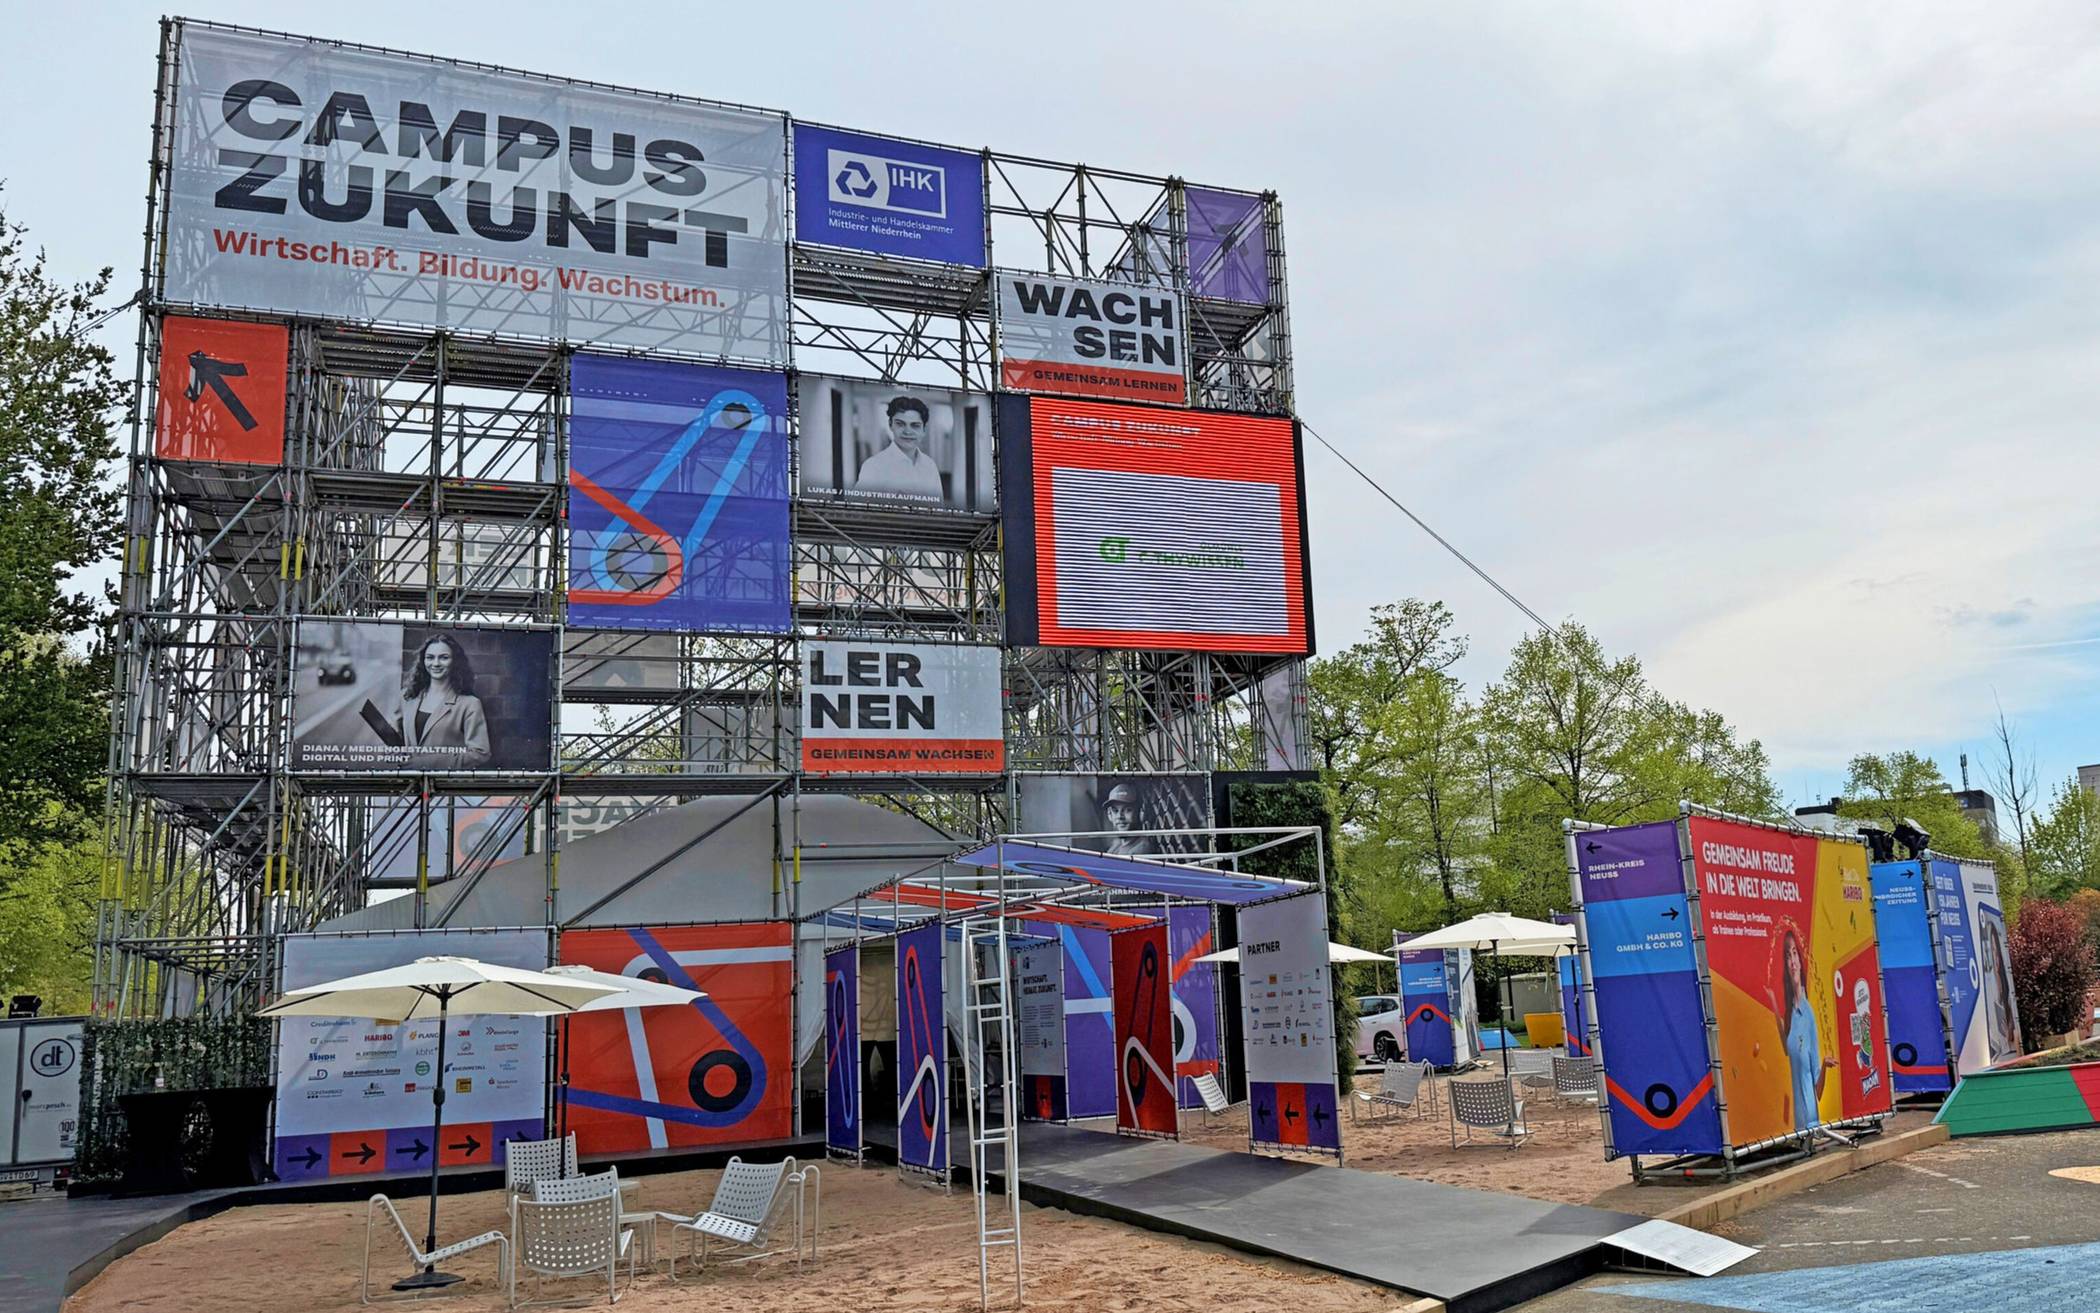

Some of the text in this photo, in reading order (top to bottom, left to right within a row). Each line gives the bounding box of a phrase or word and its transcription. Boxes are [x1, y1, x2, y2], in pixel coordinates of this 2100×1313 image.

[222, 79, 707, 197] CAMPUS
[891, 167, 934, 193] IHK
[214, 148, 749, 269] ZUKUNFT
[828, 207, 954, 234] Industrie- und Handelskammer
[828, 218, 922, 240] Mittlerer Niederrhein
[213, 228, 726, 308] Wirtschaft. Bildung. Wachstum.
[1013, 280, 1174, 330] WACH
[1073, 325, 1176, 366] SEN
[1033, 369, 1178, 393] GEMEINSAM LERNEN
[807, 486, 838, 495] LUKAS
[843, 489, 941, 503] INDUSTRIEKAUFMANN
[810, 650, 924, 688] LER
[810, 693, 936, 730] NEN
[302, 744, 339, 752] DIANA
[349, 745, 467, 754] MEDIENGESTALTERIN
[302, 754, 411, 763] DIGITAL UND PRINT
[810, 748, 995, 761] GEMEINSAM WACHSEN
[1588, 859, 1646, 872] RHEIN-KREIS
[1702, 841, 1796, 875] GEMEINSAM FREUDE
[1589, 871, 1619, 880] NEUSS
[1705, 871, 1803, 903] IN DIE WELT BRINGEN.
[1616, 939, 1684, 953] GMBH & CO. KG
[1646, 931, 1683, 941] HARIBO
[1247, 940, 1281, 956] PARTNER
[364, 1033, 393, 1042] HARIBO
[40, 1045, 64, 1068] dt
[60, 1120, 76, 1134] 100
